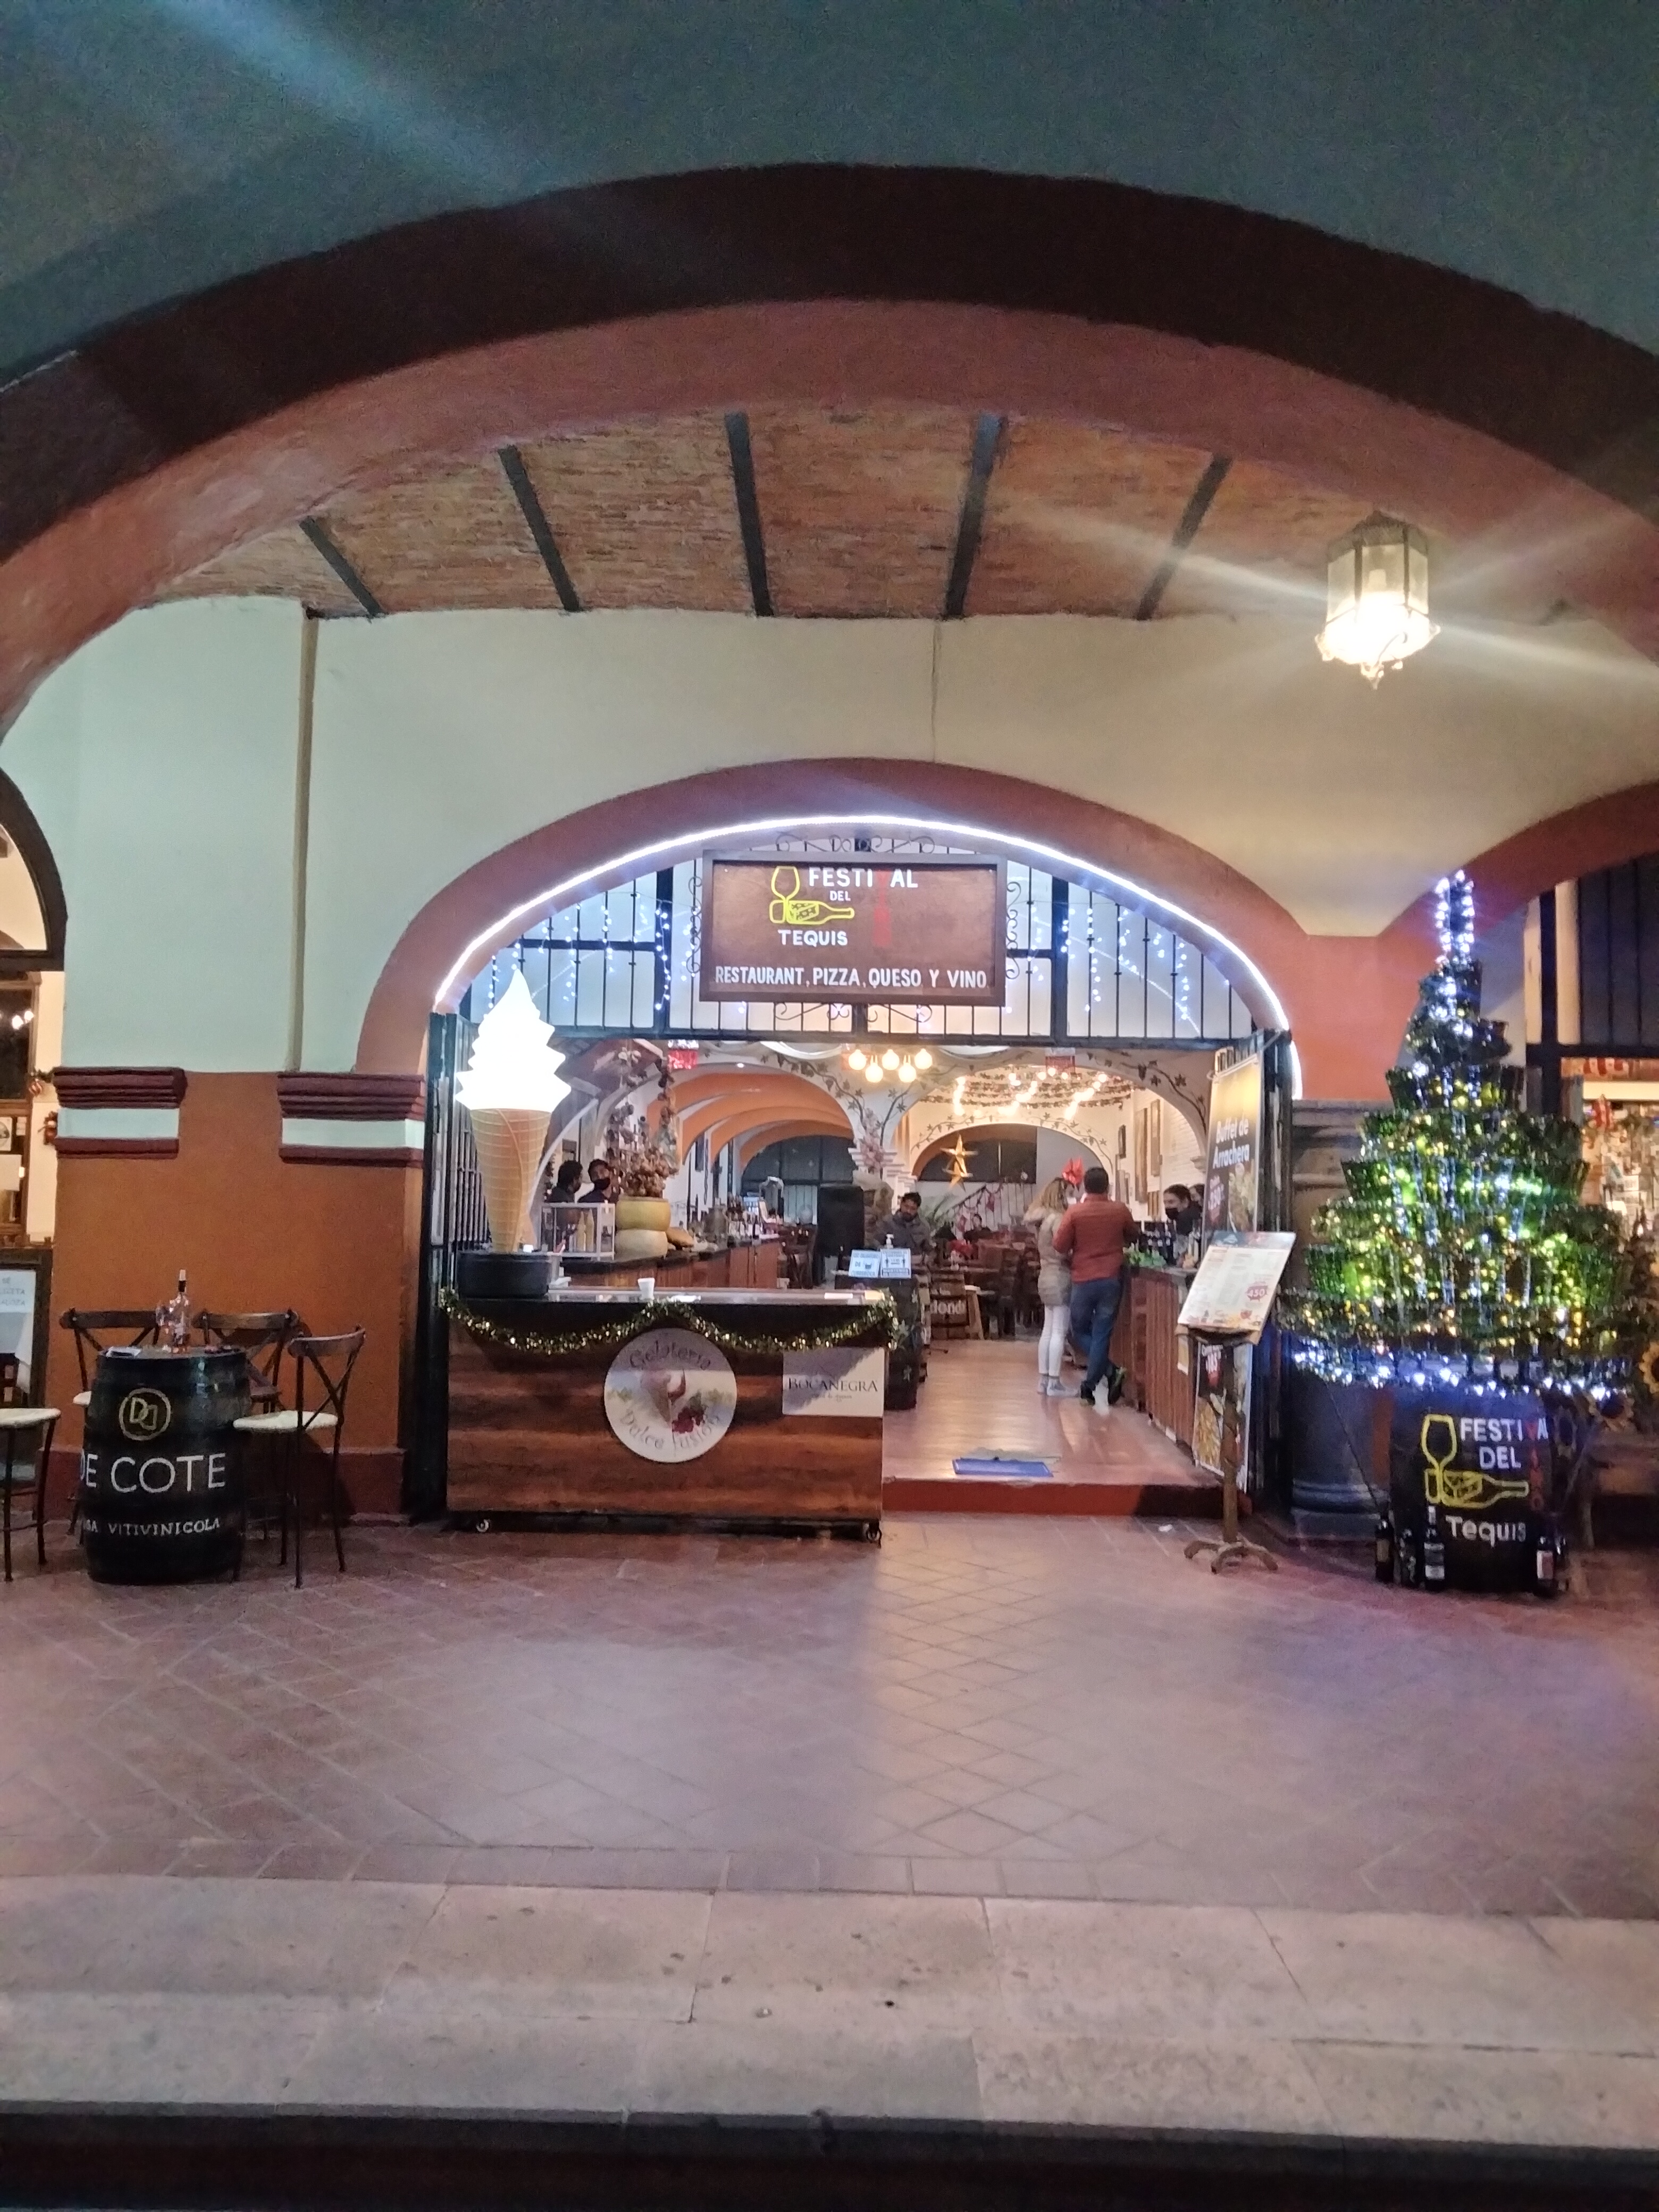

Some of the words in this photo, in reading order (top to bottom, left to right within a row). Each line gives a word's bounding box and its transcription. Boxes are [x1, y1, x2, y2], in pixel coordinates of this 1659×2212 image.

[830, 890, 851, 901] DEL
[778, 929, 848, 947] TEQUIS
[868, 968, 922, 988] QUESO
[929, 969, 940, 988] Y
[947, 970, 987, 988] VINO
[1216, 1117, 1238, 1144] Buffet
[1239, 1116, 1249, 1136] de
[1212, 1140, 1250, 1169] Arrachera
[789, 1378, 878, 1392] BOCANEGRA
[1479, 1446, 1522, 1470] DEL
[111, 1453, 226, 1493] COTE
[108, 1518, 220, 1536] VITIVINICOLA
